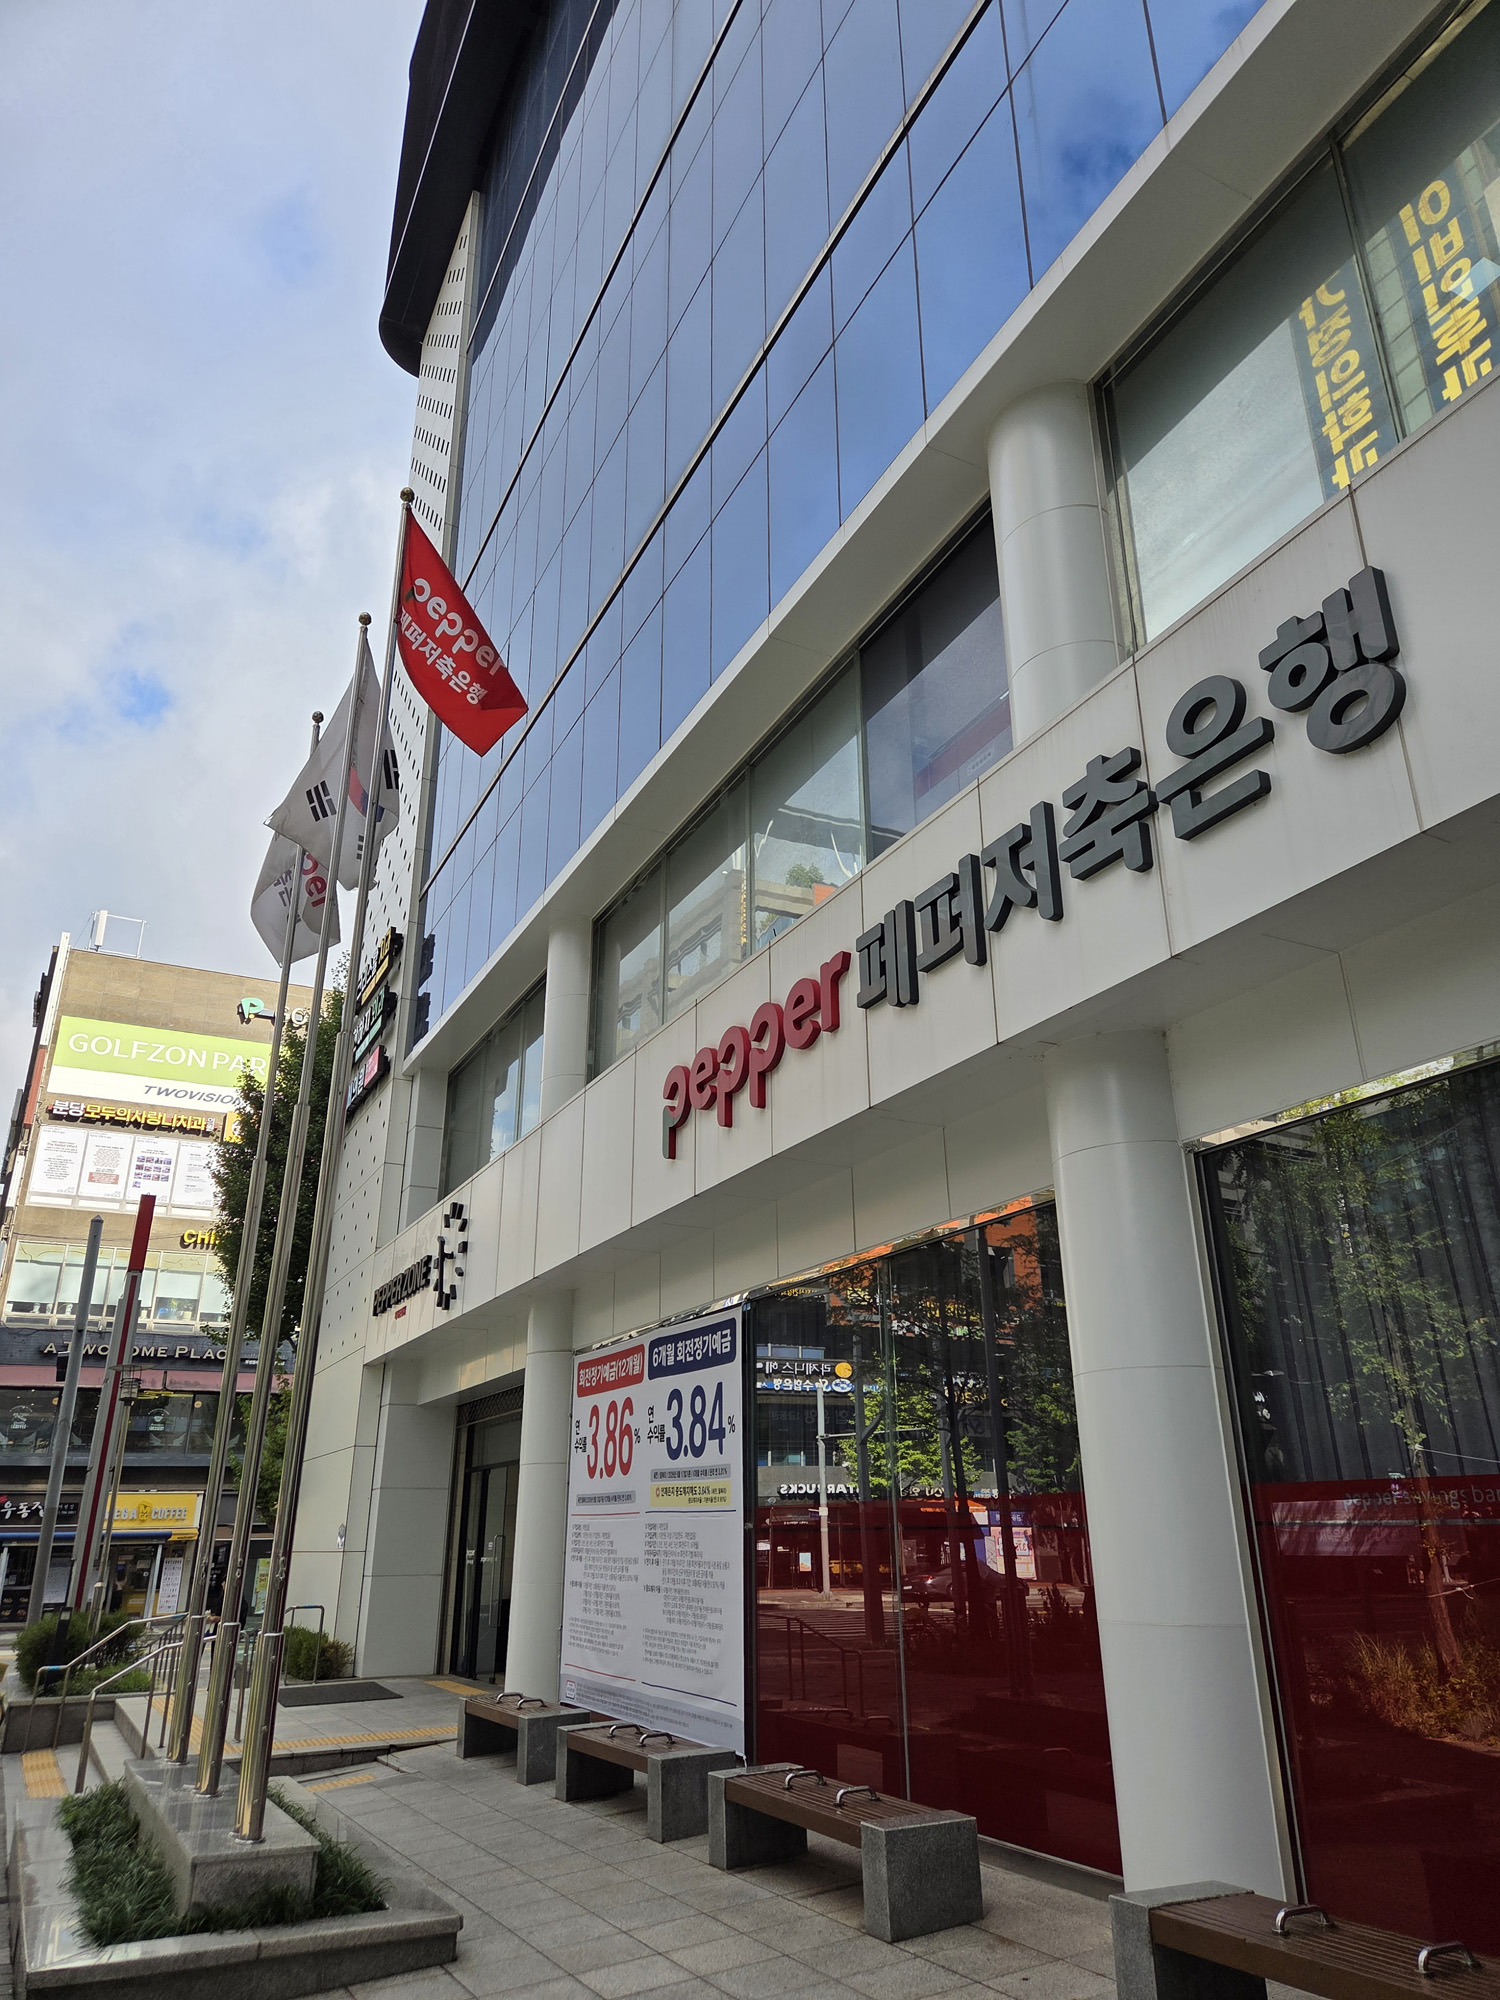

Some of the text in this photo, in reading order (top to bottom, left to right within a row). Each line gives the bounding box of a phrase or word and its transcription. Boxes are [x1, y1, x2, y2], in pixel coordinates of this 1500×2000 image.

[406, 578, 507, 675] pepper
[662, 565, 1407, 1160] pepper 페퍼저축은행
[69, 1033, 267, 1077] GOLFZON PAR
[175, 1345, 228, 1360] PLAC
[652, 1328, 732, 1367] 6개월 회전정기예금
[151, 1507, 187, 1520] COFFEE
